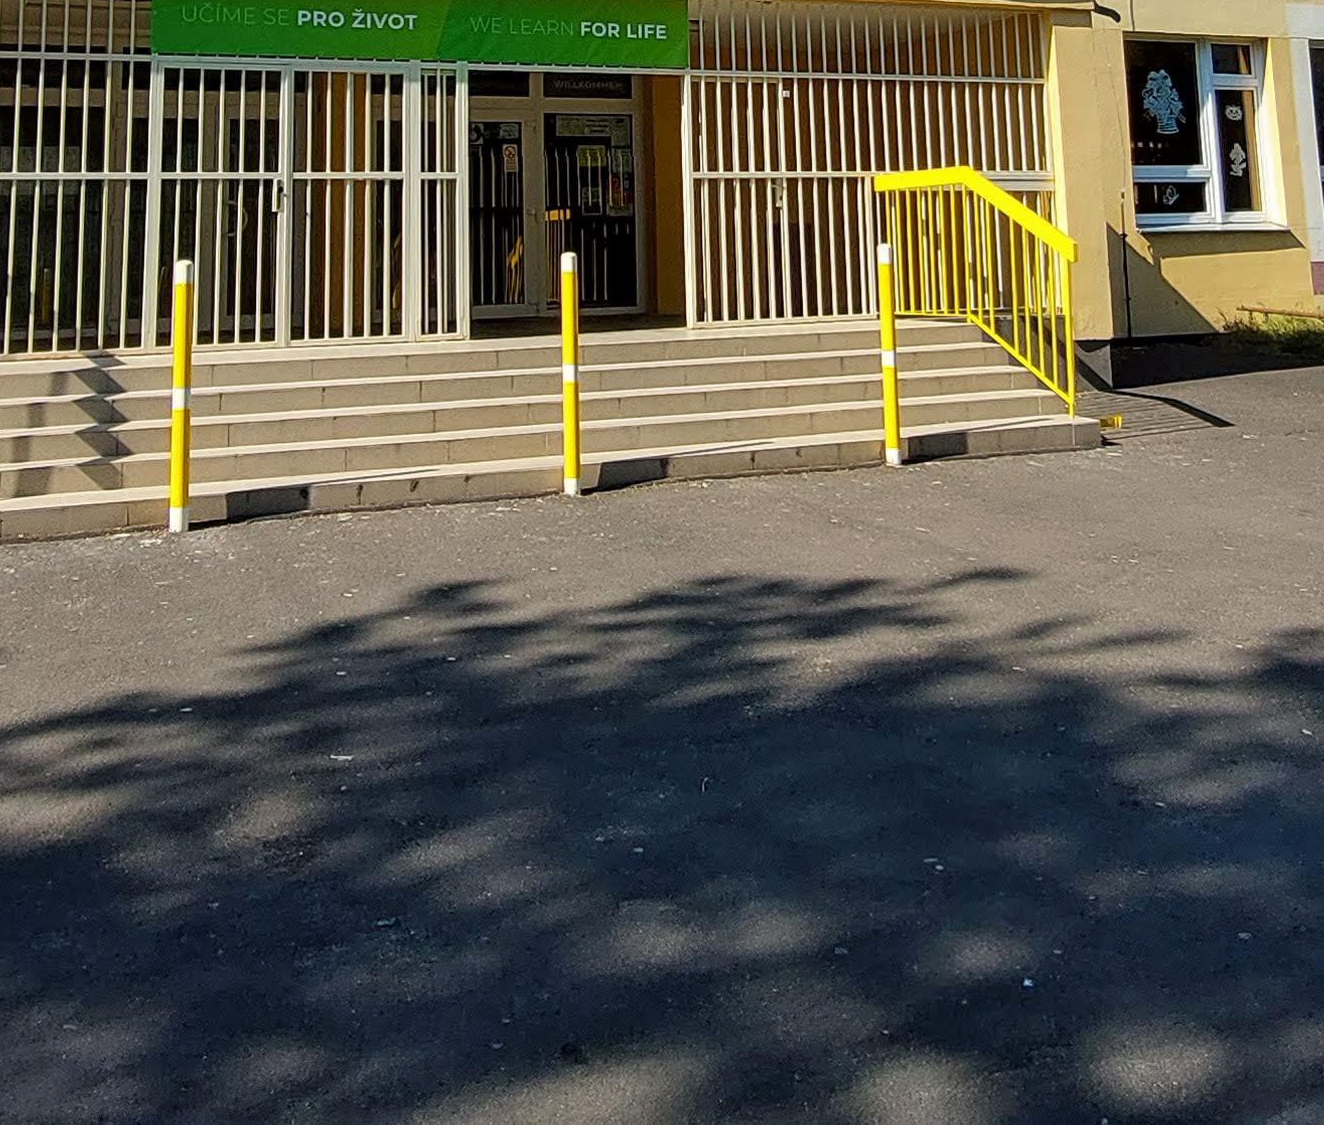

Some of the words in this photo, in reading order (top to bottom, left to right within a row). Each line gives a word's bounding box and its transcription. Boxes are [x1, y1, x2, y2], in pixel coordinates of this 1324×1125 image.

[181, 2, 256, 26] UČÍME
[263, 7, 290, 26] SE
[297, 9, 345, 28] PRO
[351, 8, 418, 30] ŽIVOT
[470, 17, 502, 34] WE
[509, 18, 573, 36] LEARN
[580, 21, 620, 38] FOR
[626, 23, 668, 40] LIFE
